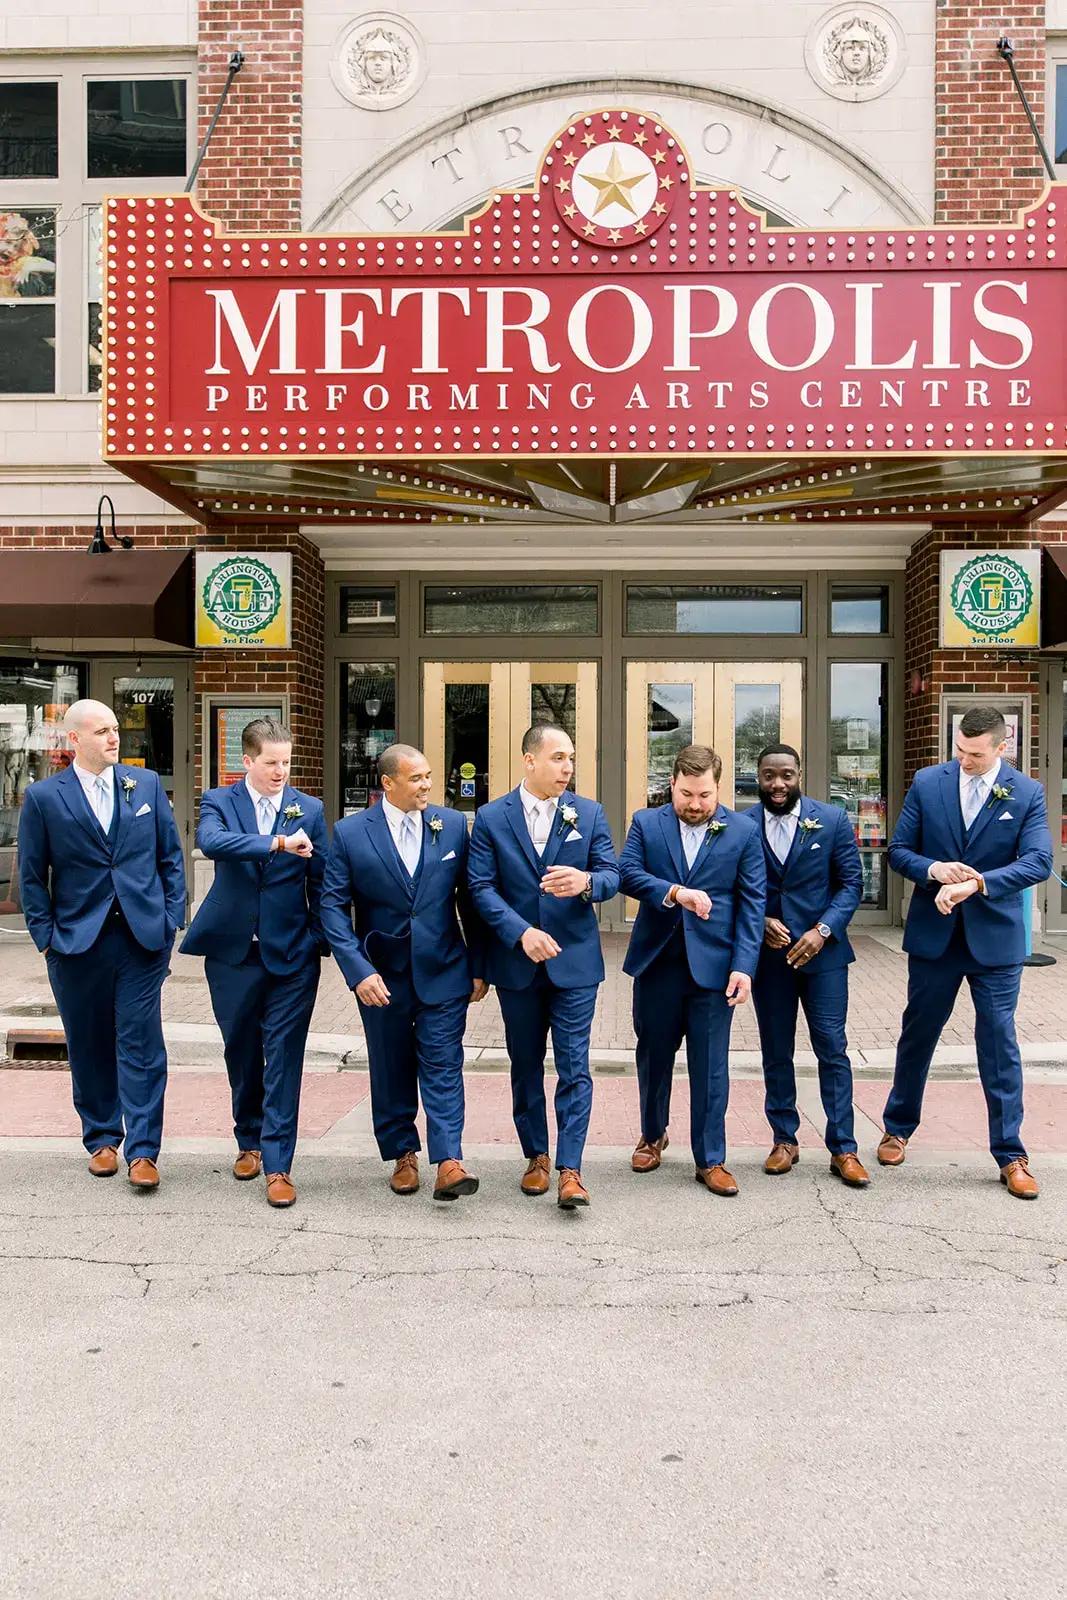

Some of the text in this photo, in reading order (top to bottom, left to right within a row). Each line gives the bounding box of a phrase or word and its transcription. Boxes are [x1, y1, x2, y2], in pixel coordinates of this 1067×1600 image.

[204, 280, 1033, 376] METROPOLIS
[206, 379, 1031, 412] PERFORMING ARTS CENTRE
[214, 565, 271, 589] ARLINGTON
[962, 562, 1022, 587] ARLINGTON
[207, 590, 274, 613] ALE
[955, 588, 1025, 612] ALE
[222, 614, 263, 628] HOUSE
[970, 613, 1013, 627] HOUSE
[222, 636, 265, 644] 3rd Floor
[971, 636, 1016, 644] 3rd Floor
[132, 692, 155, 703] 107
